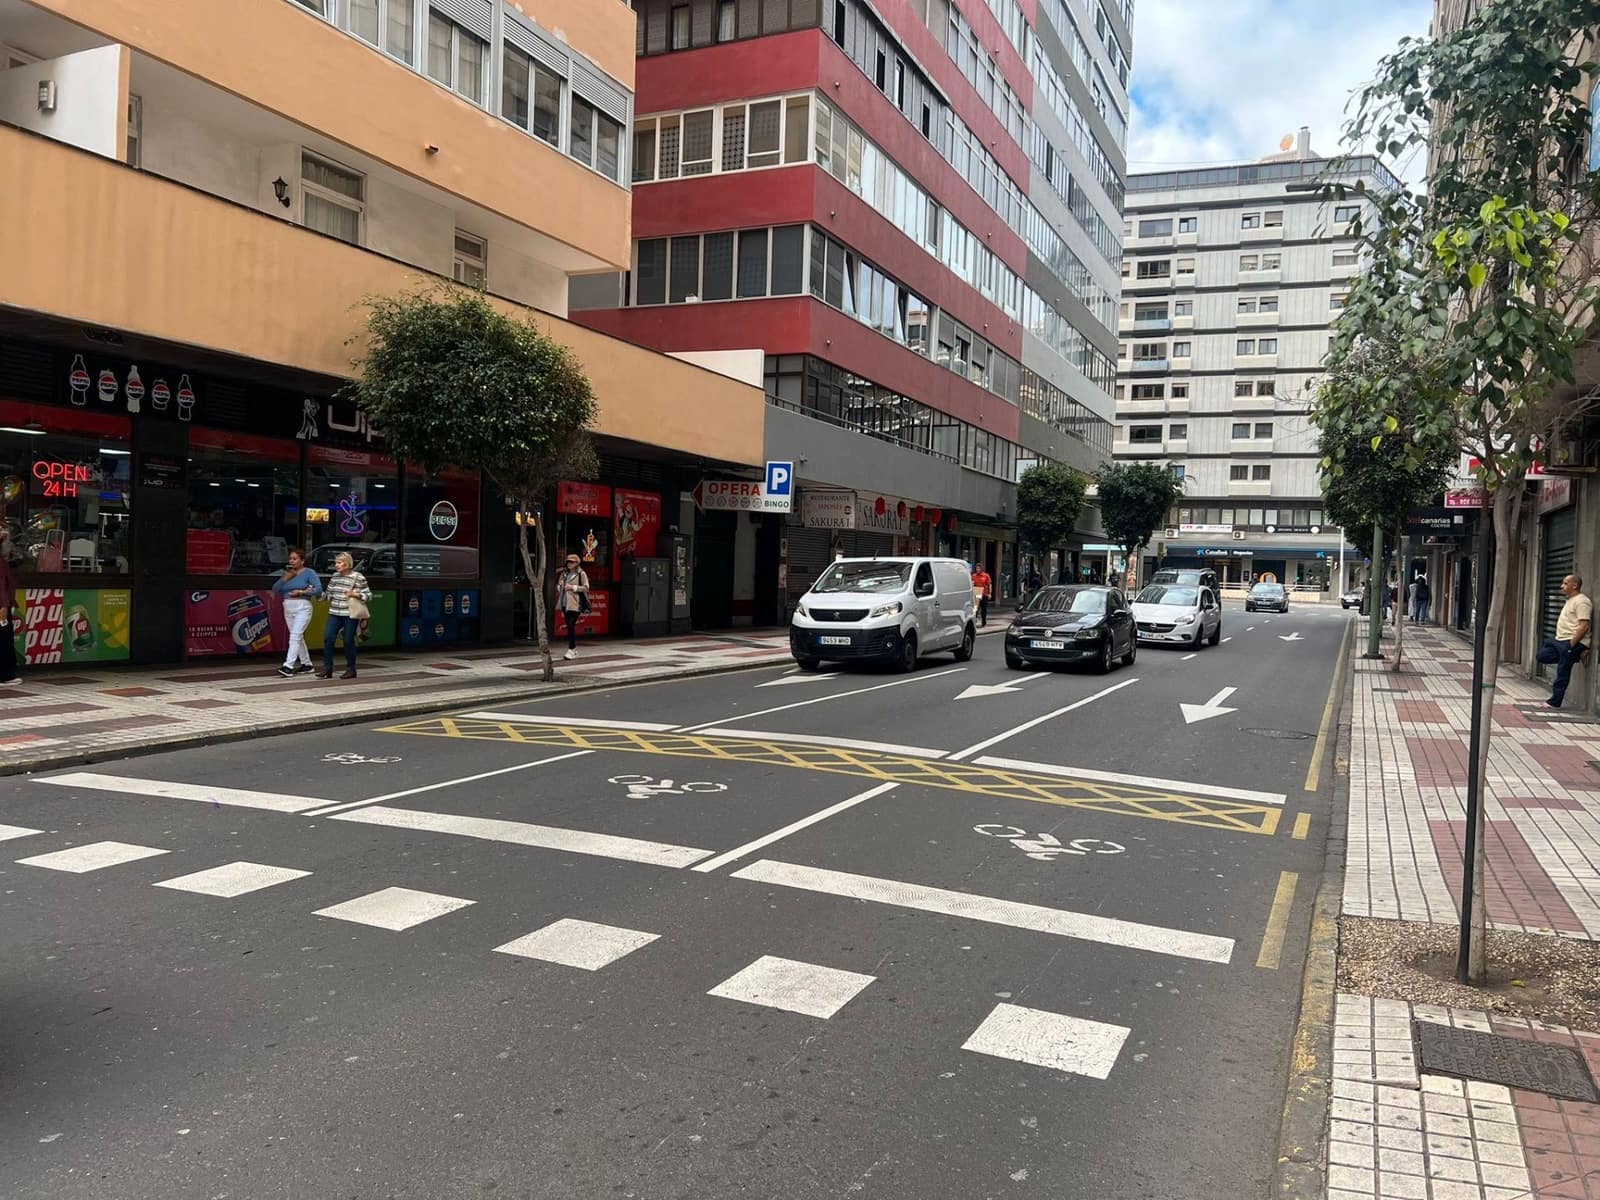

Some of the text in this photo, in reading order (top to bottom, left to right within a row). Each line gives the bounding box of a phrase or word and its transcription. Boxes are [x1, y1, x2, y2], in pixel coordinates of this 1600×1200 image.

[33, 461, 88, 481] OPEN
[771, 467, 789, 491] P
[43, 480, 77, 498] 24 H
[709, 482, 761, 496] OPERA
[576, 502, 598, 515] 24 H
[764, 500, 790, 508] BINGO
[431, 515, 456, 525] PEPSI
[641, 512, 657, 523] 24 H
[810, 517, 845, 528] SAKURA
[232, 617, 269, 646] Clipper
